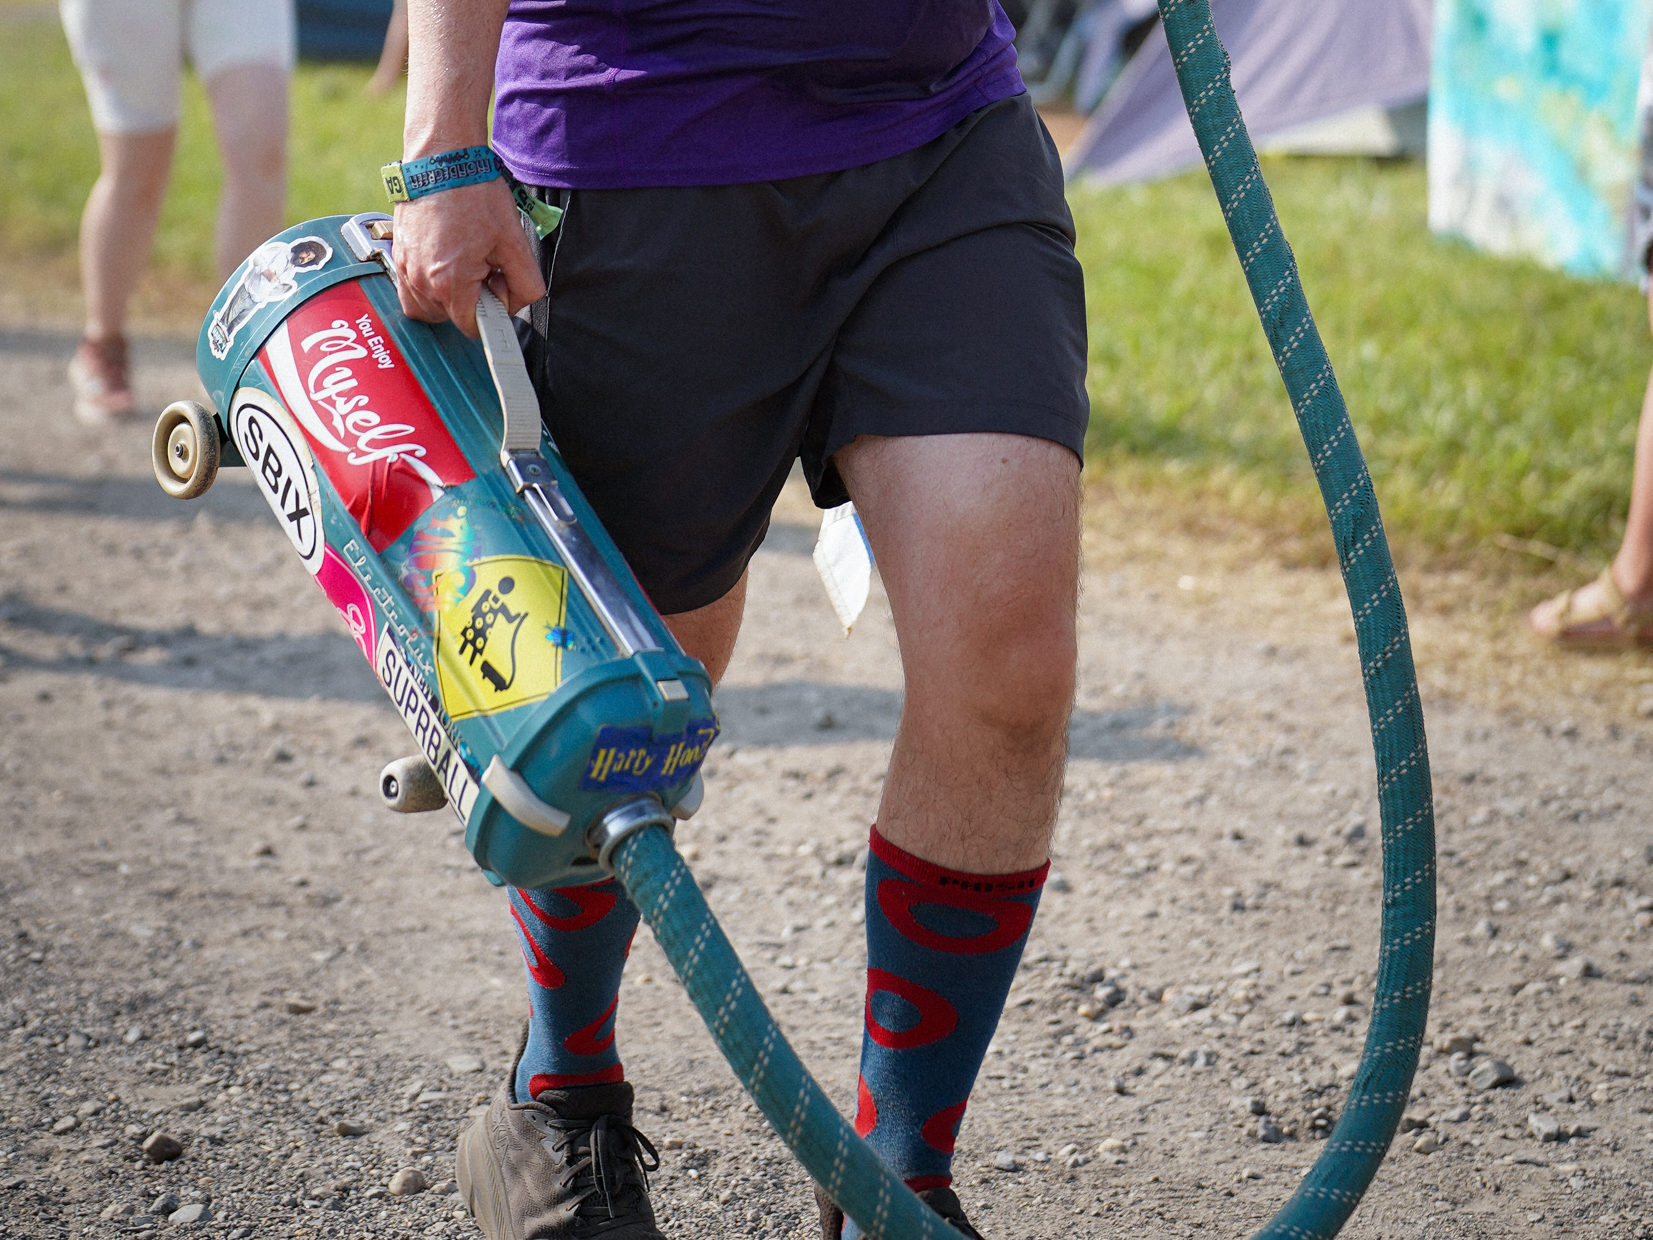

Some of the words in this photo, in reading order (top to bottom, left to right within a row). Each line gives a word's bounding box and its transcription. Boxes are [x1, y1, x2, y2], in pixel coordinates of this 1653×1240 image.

[385, 176, 402, 194] GA
[355, 313, 376, 337] You
[369, 335, 395, 369] Enjoy
[301, 319, 427, 465] Myself
[244, 415, 310, 545] SBIX
[343, 538, 434, 676] Electrolux
[409, 662, 435, 702] NEW
[382, 649, 469, 822] SUPRBALL
[590, 746, 656, 782] Harry
